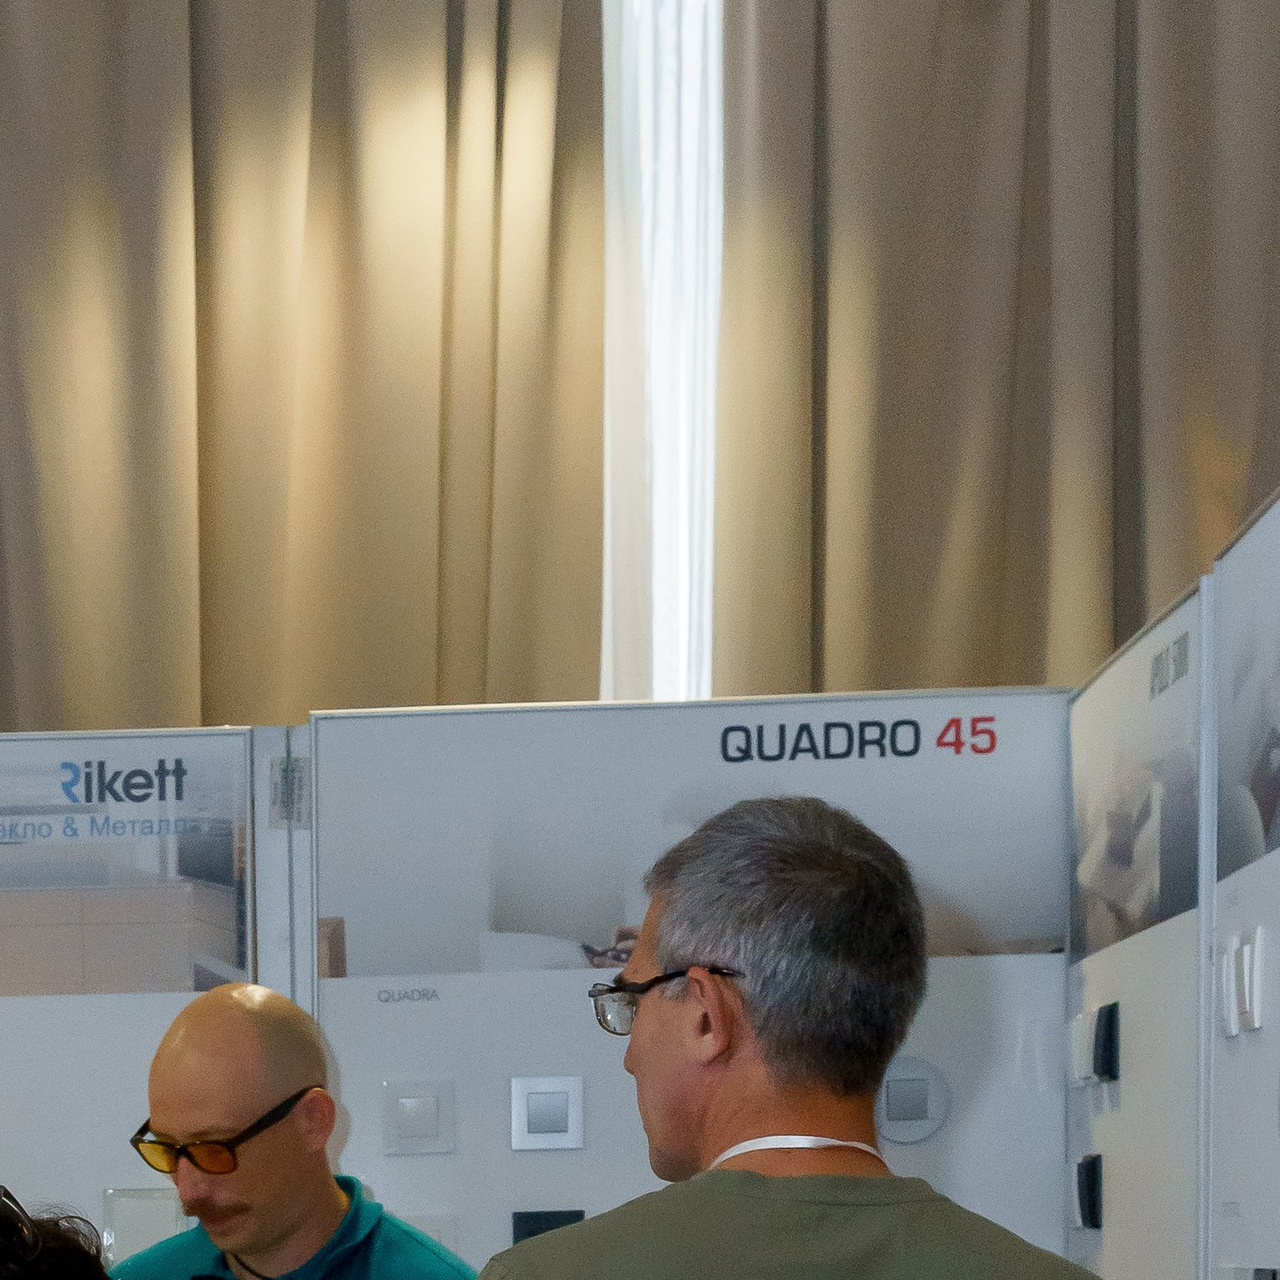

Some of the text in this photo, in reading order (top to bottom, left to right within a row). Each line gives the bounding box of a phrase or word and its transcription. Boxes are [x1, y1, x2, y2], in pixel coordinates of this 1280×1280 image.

[720, 716, 998, 763] QUADRO 45
[59, 757, 188, 804] Rikett
[62, 815, 80, 838] &
